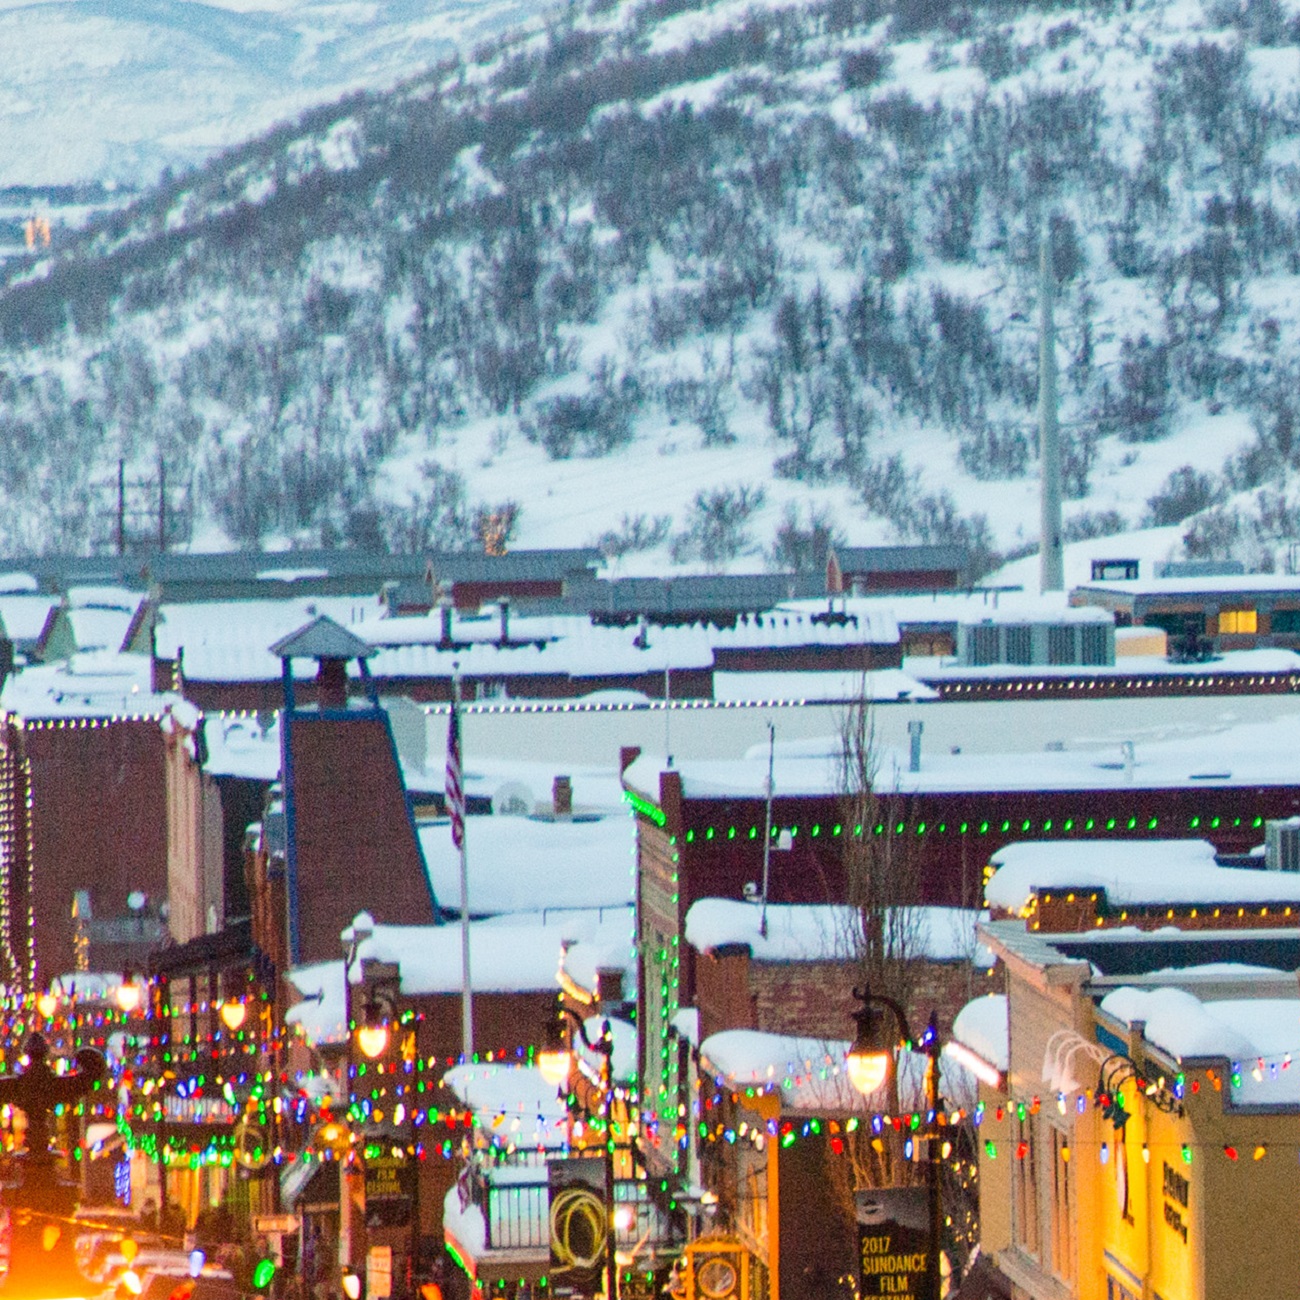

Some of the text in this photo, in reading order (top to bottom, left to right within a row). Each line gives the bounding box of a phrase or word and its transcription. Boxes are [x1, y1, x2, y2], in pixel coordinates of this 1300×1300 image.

[862, 1236, 891, 1254] 2017
[863, 1254, 927, 1275] SUNDANCE
[880, 1276, 908, 1293] FILM
